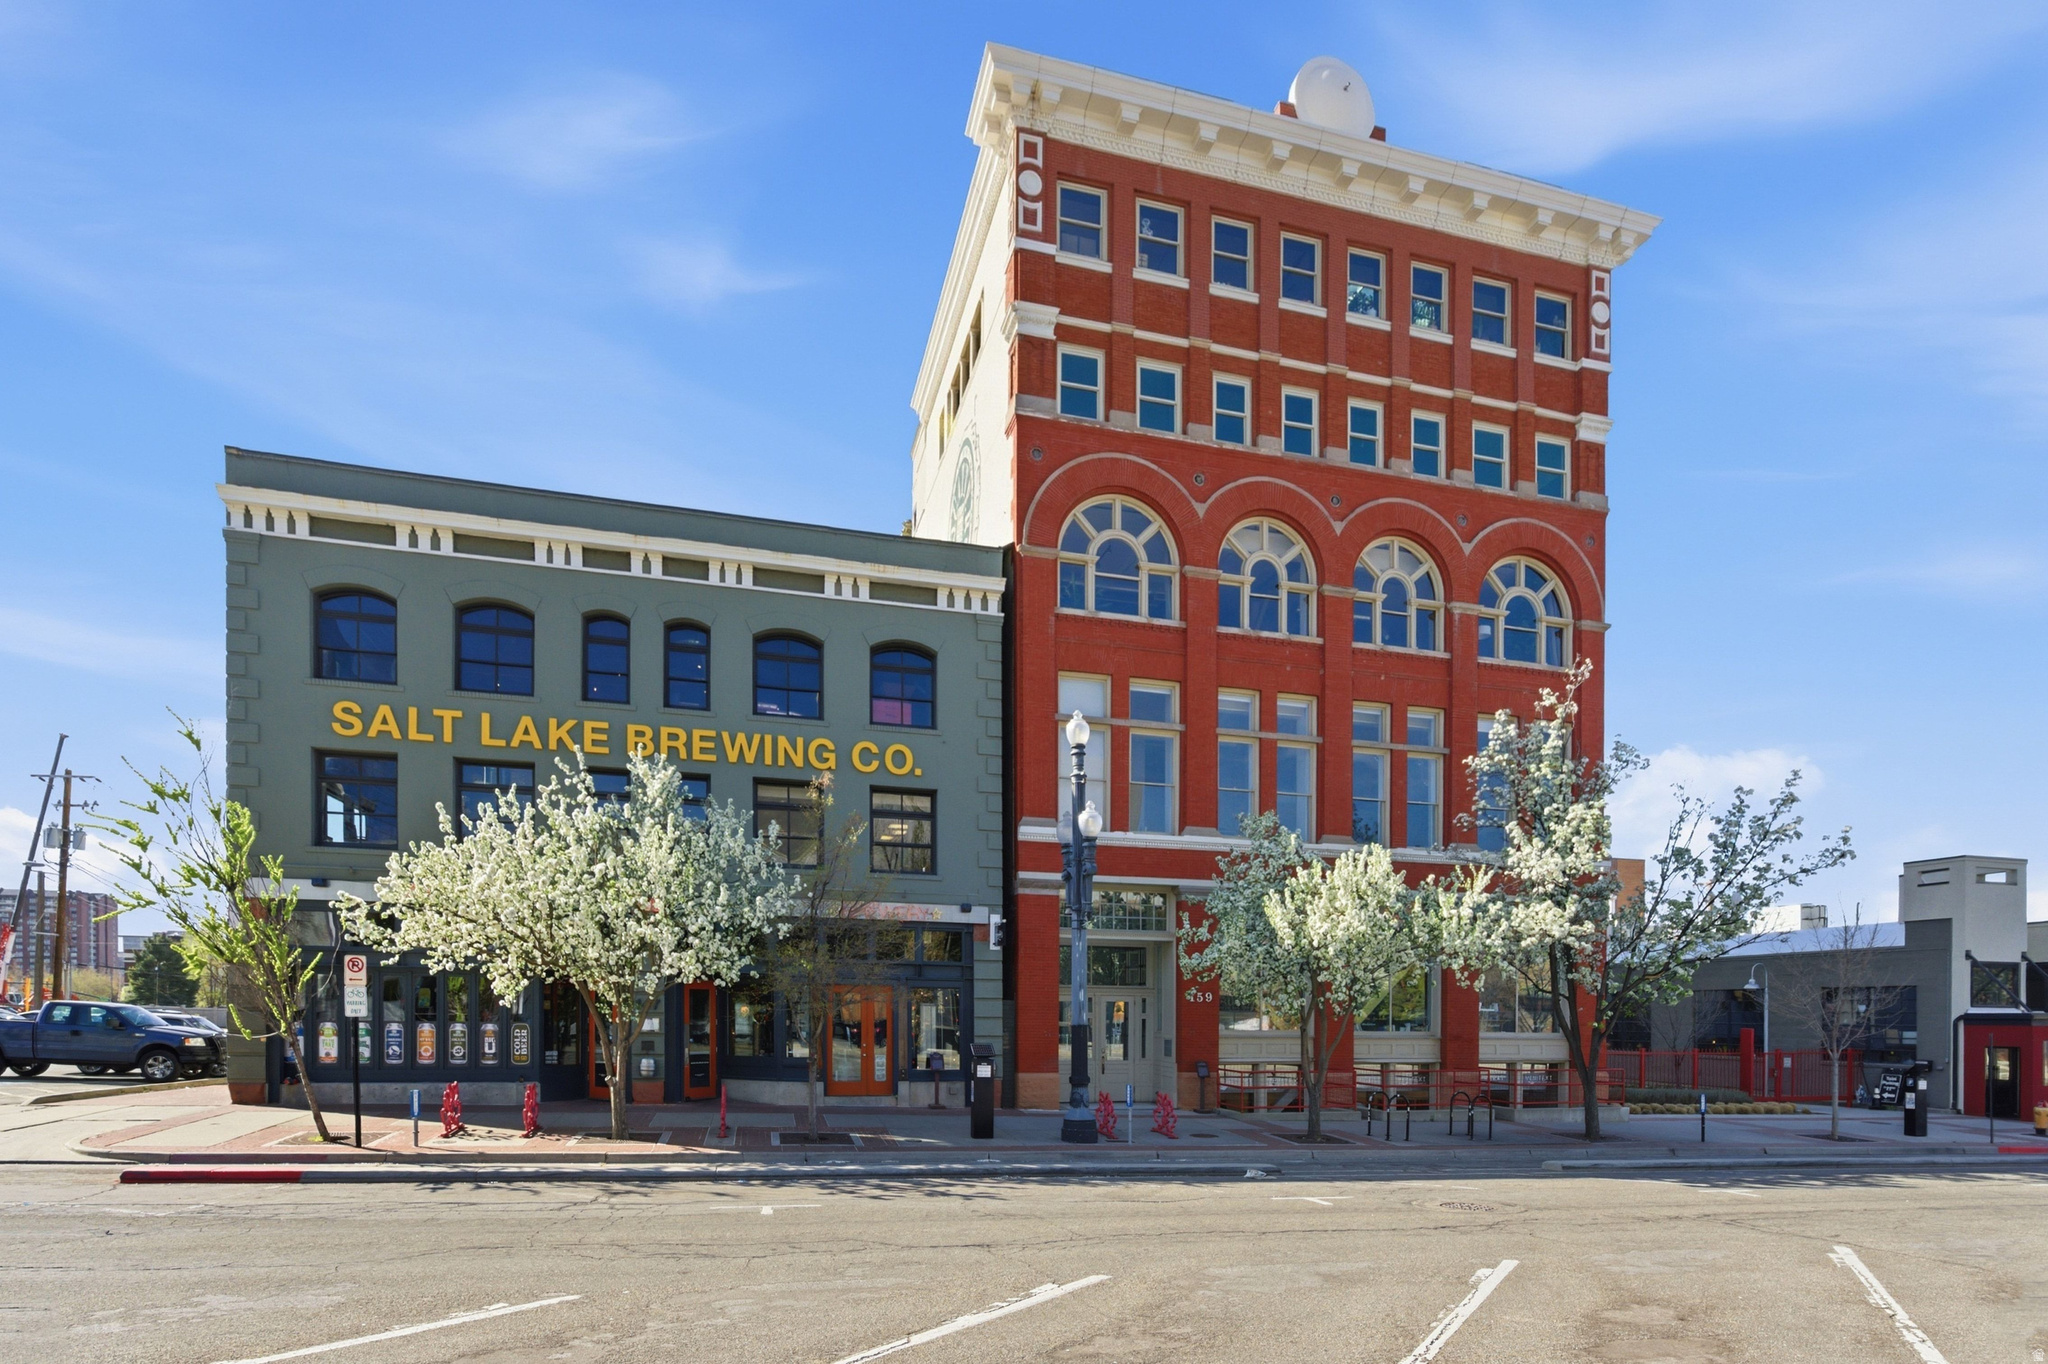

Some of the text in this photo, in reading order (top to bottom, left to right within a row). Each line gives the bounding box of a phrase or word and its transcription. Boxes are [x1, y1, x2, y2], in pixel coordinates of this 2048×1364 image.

[331, 701, 923, 776] SALT LAKE BREWING CO.
